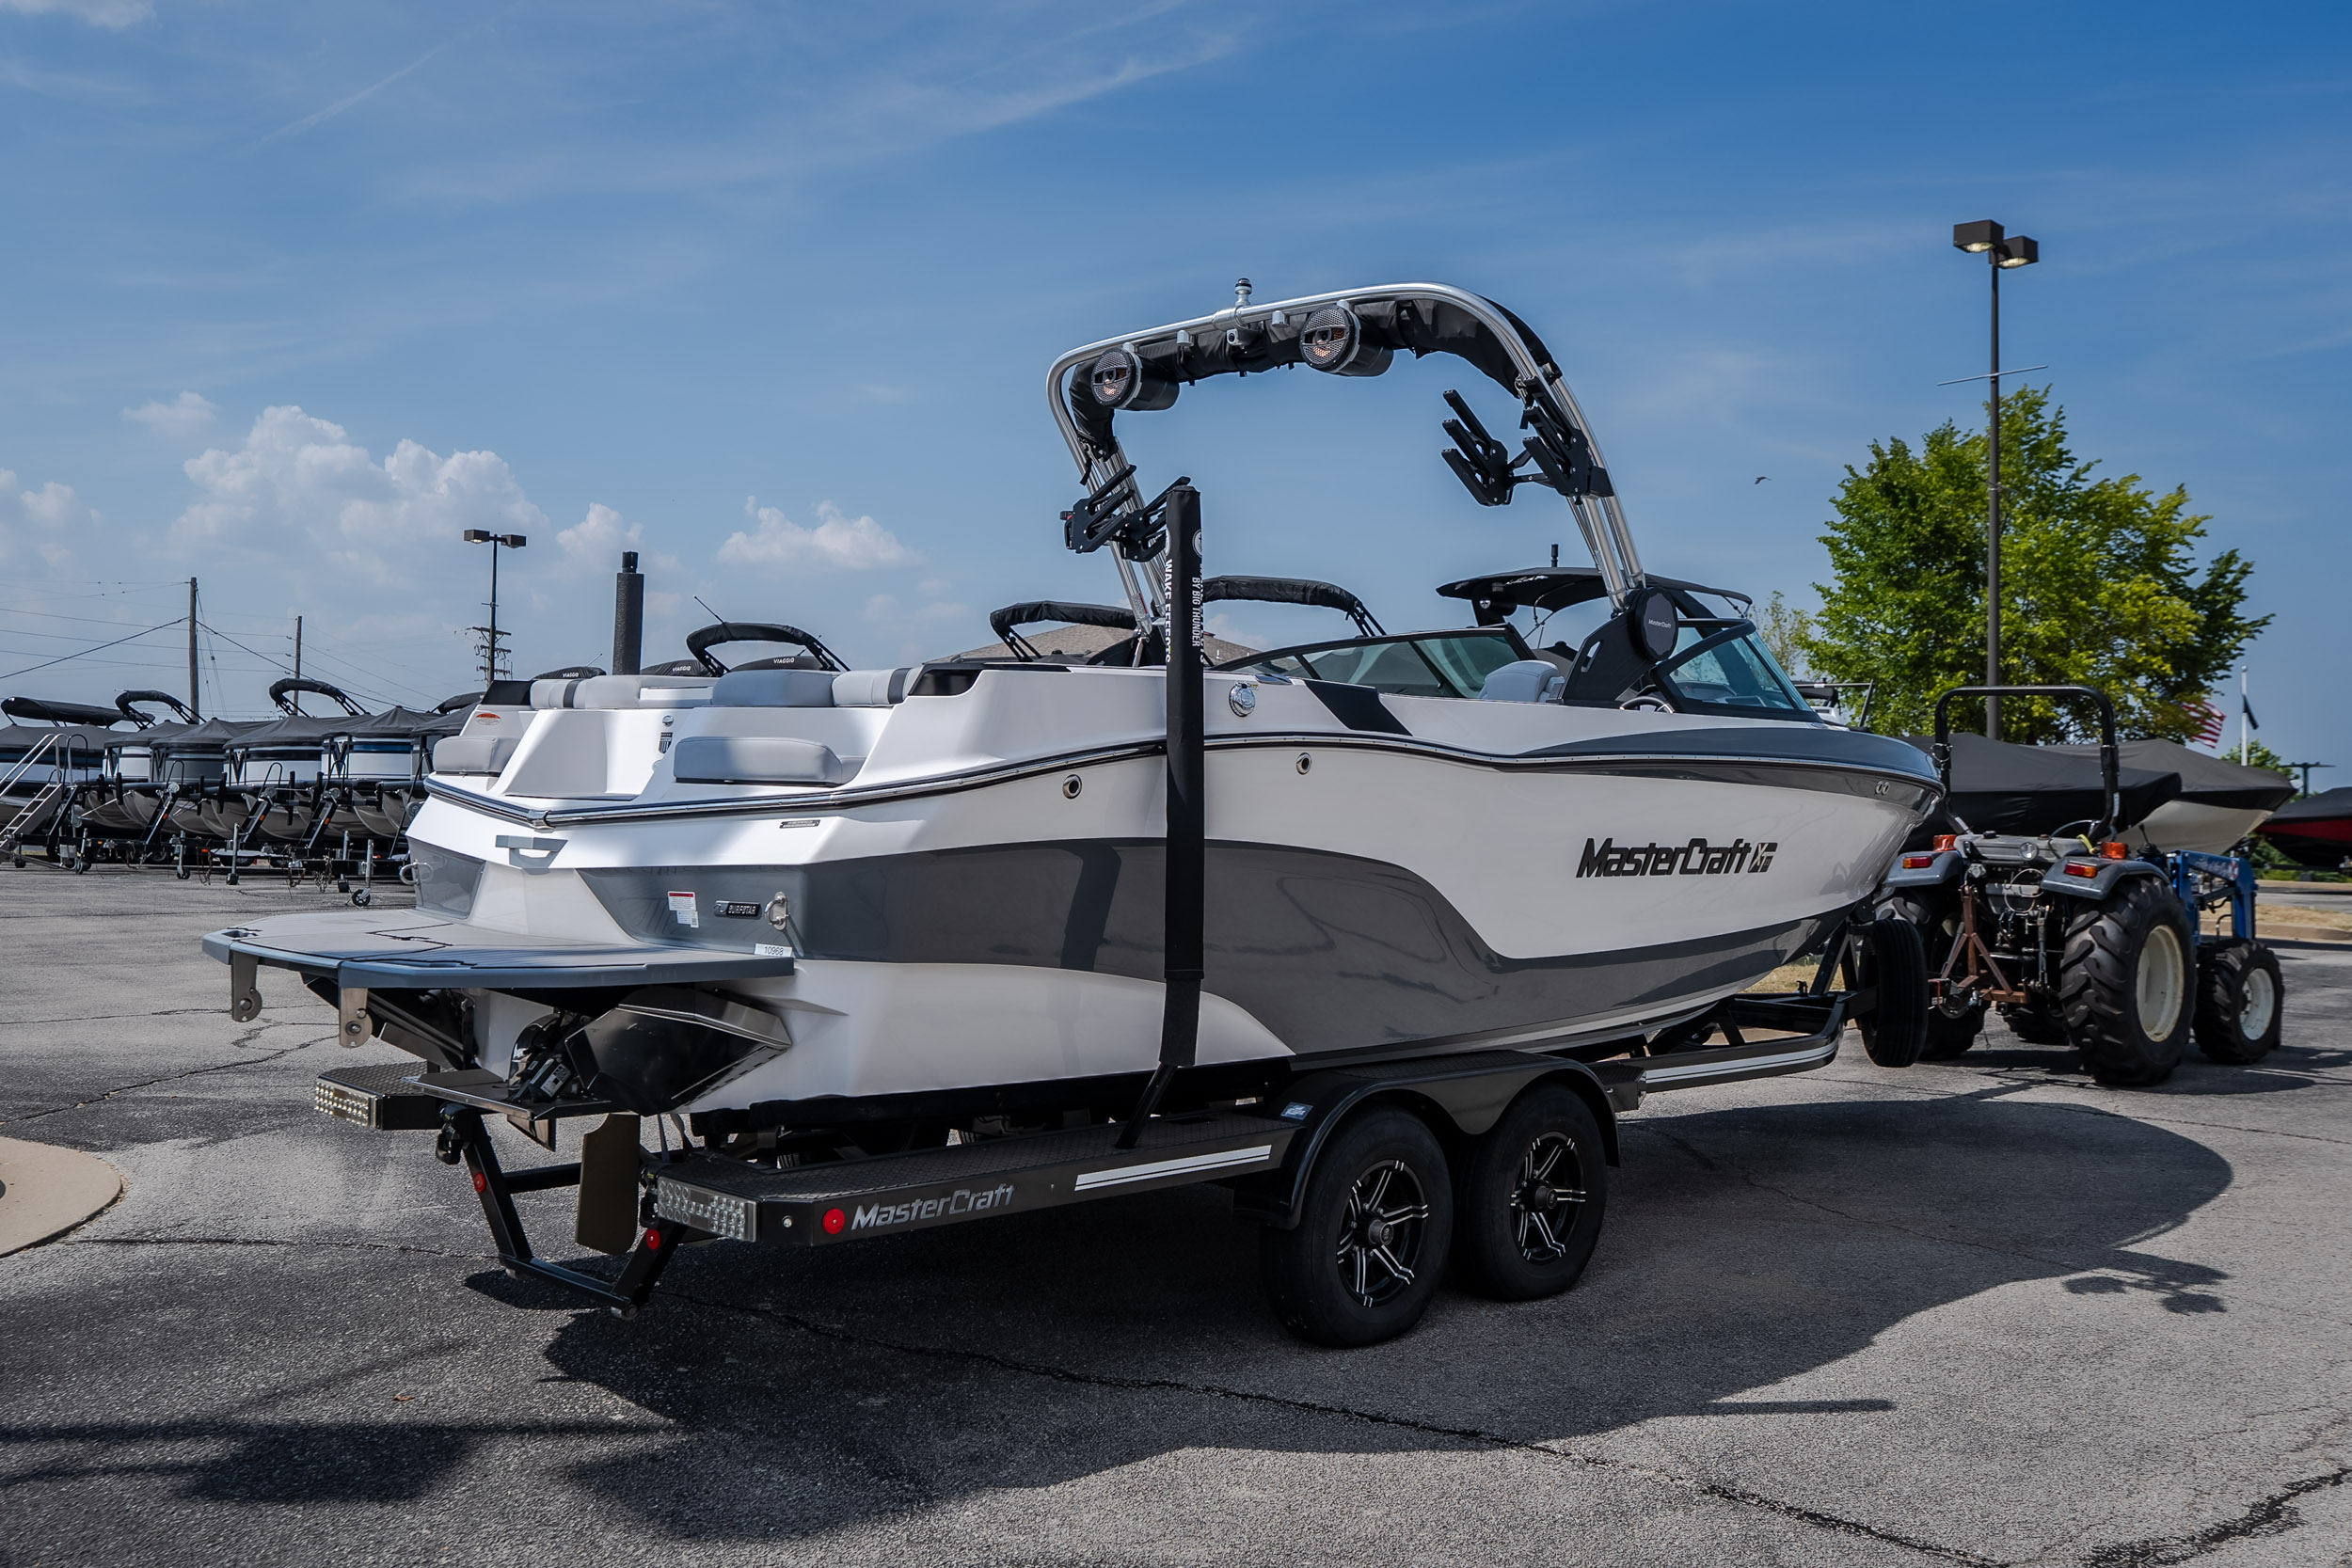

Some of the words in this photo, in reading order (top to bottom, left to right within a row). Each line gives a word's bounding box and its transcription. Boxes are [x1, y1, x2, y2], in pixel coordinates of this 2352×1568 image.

[1192, 577, 1200, 590] BY
[1192, 590, 1201, 606] BIG
[1192, 608, 1201, 646] THUNDER
[1575, 837, 1753, 878] MasterCraft
[764, 945, 785, 957] 10968
[850, 1182, 1017, 1231] MasterCraft
